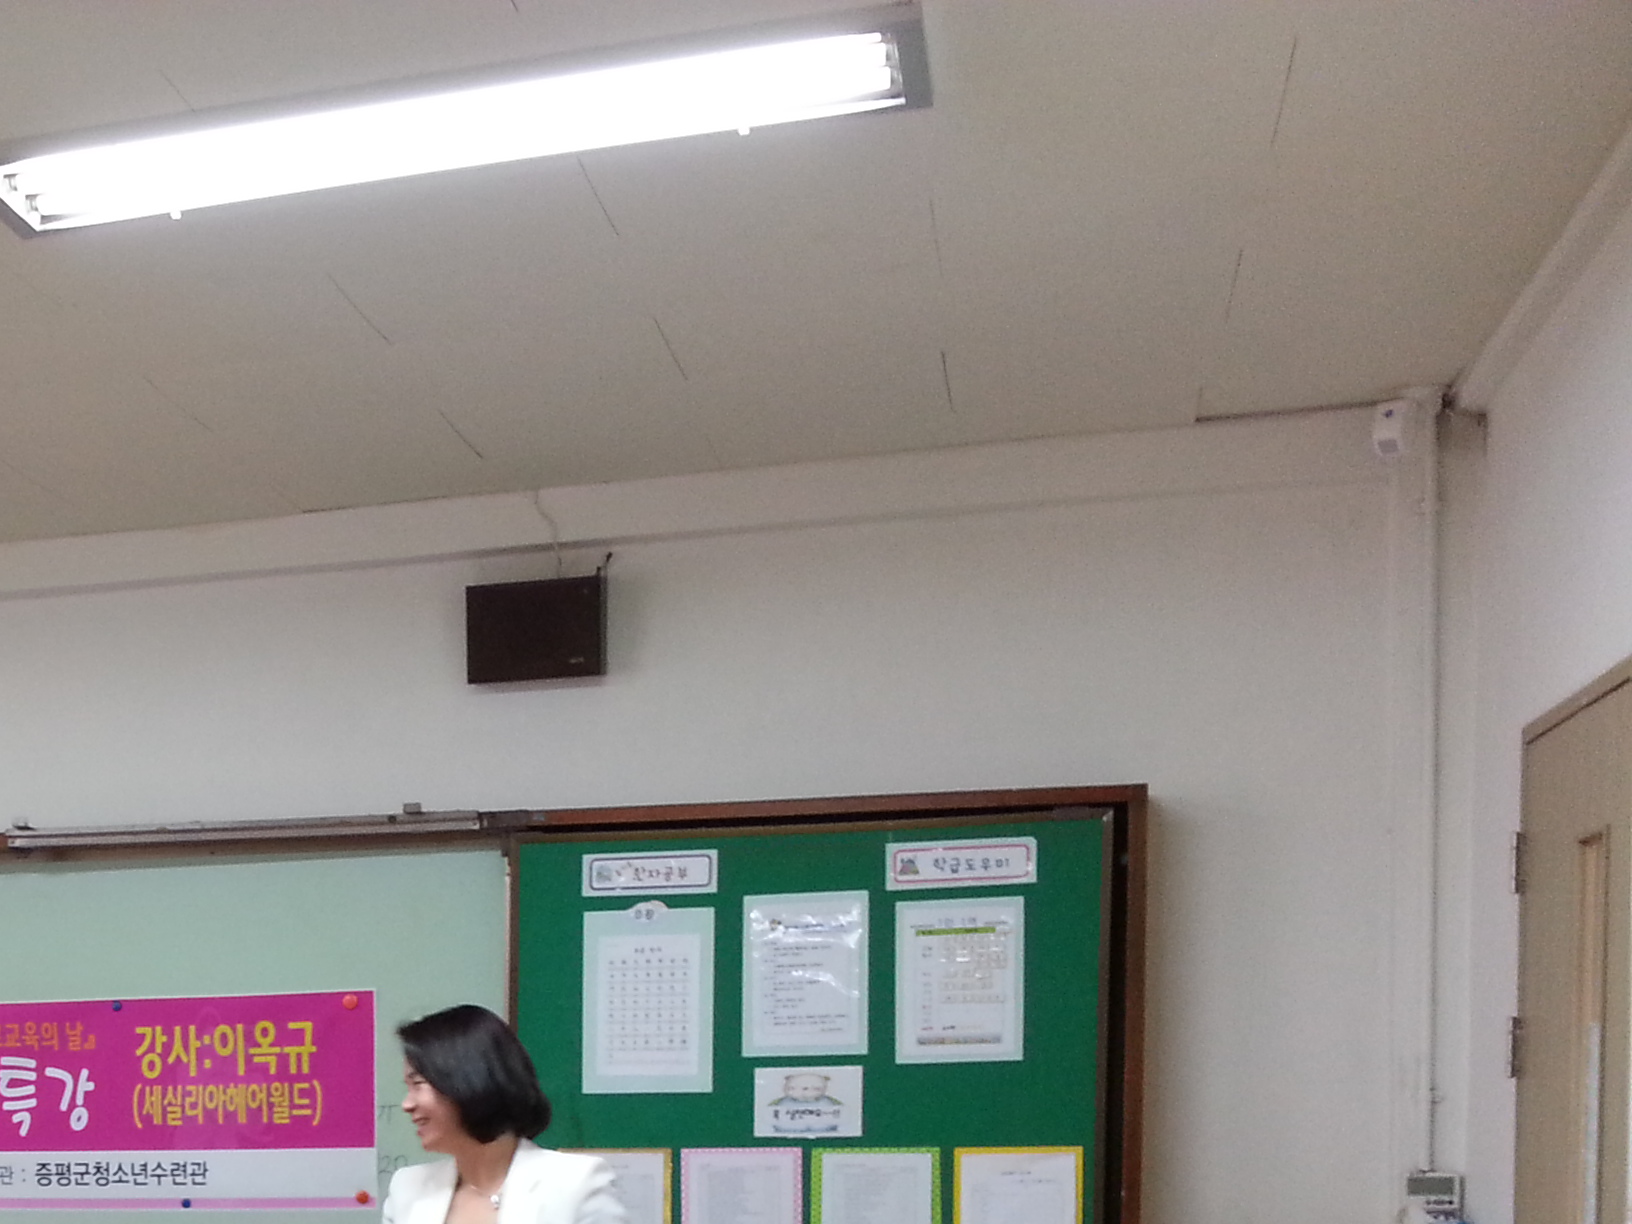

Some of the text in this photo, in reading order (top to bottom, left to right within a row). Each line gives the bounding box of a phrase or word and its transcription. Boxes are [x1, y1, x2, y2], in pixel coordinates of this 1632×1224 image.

[135, 1020, 317, 1079] 강사:이옥규
[133, 1079, 323, 1129] (세실리아헤어월드)
[34, 1161, 209, 1187] 증평군청소년수련관
